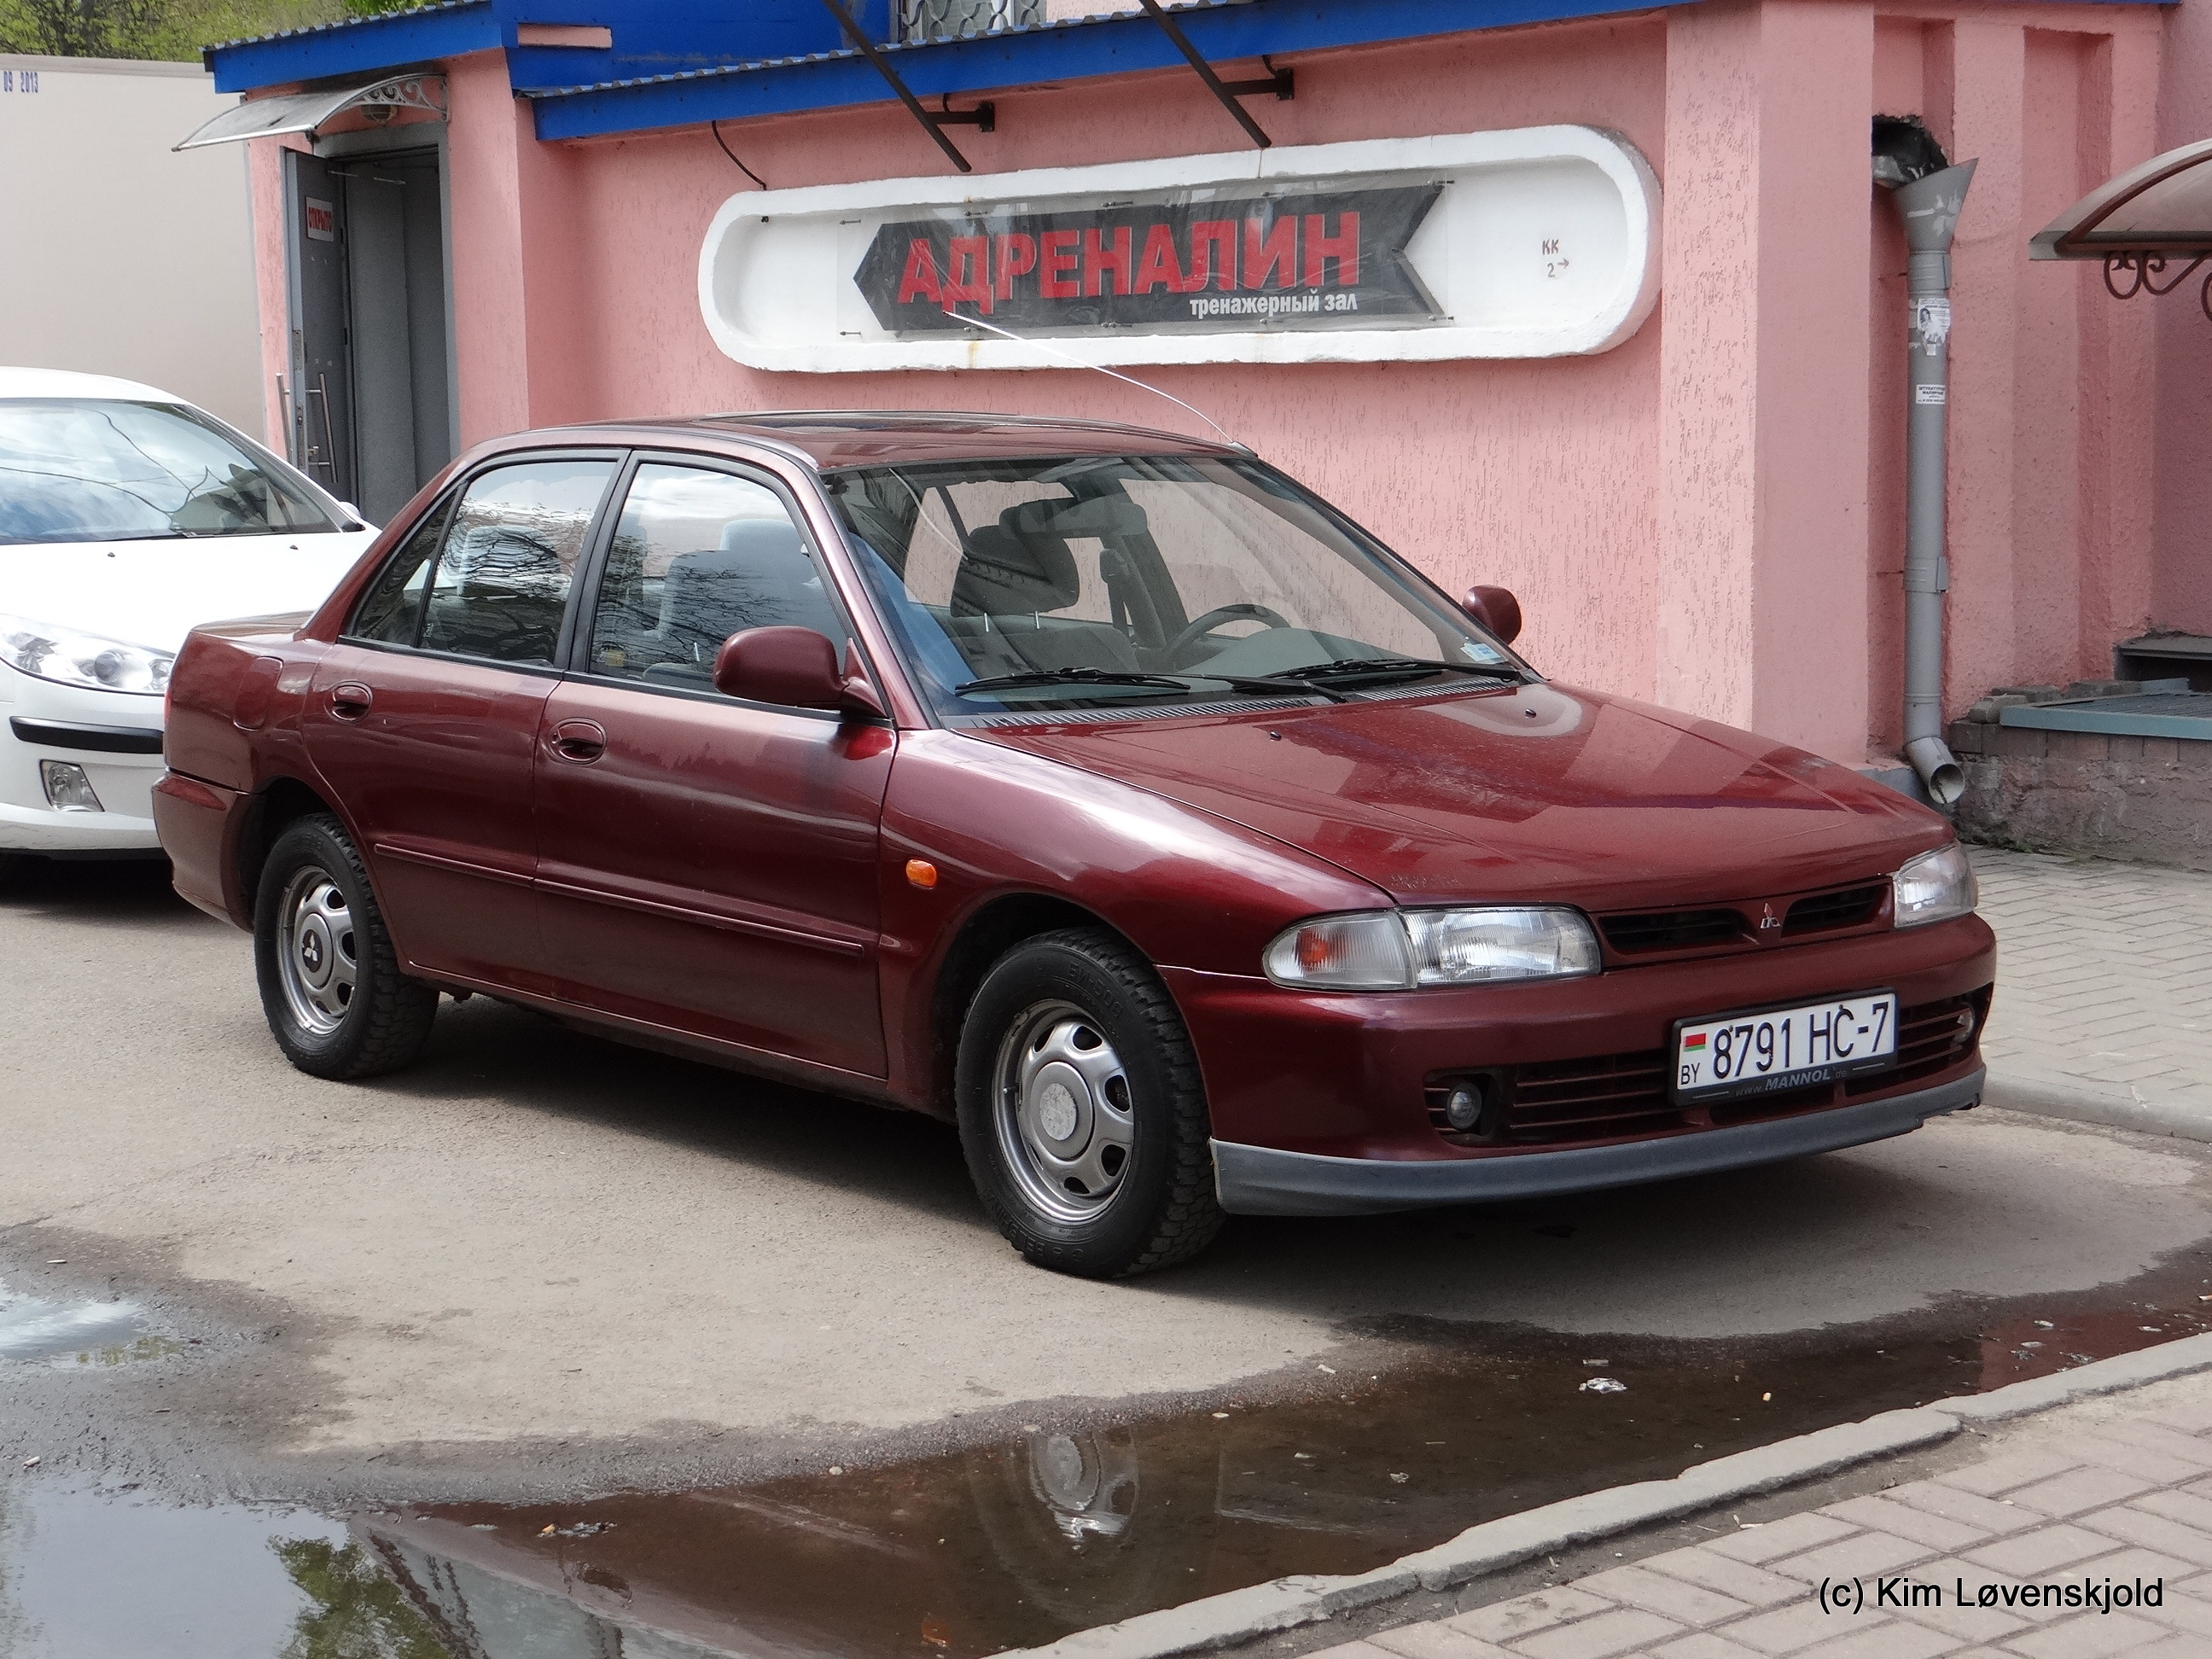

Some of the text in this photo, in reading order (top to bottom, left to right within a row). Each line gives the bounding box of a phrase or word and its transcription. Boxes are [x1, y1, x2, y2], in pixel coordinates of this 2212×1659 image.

[20, 71, 39, 93] 2013
[898, 211, 1360, 315] АДРЕНАЛИН
[1190, 288, 1358, 319] тренажерный зал
[1712, 1018, 1791, 1080] 8791
[1680, 1062, 1701, 1085] BY
